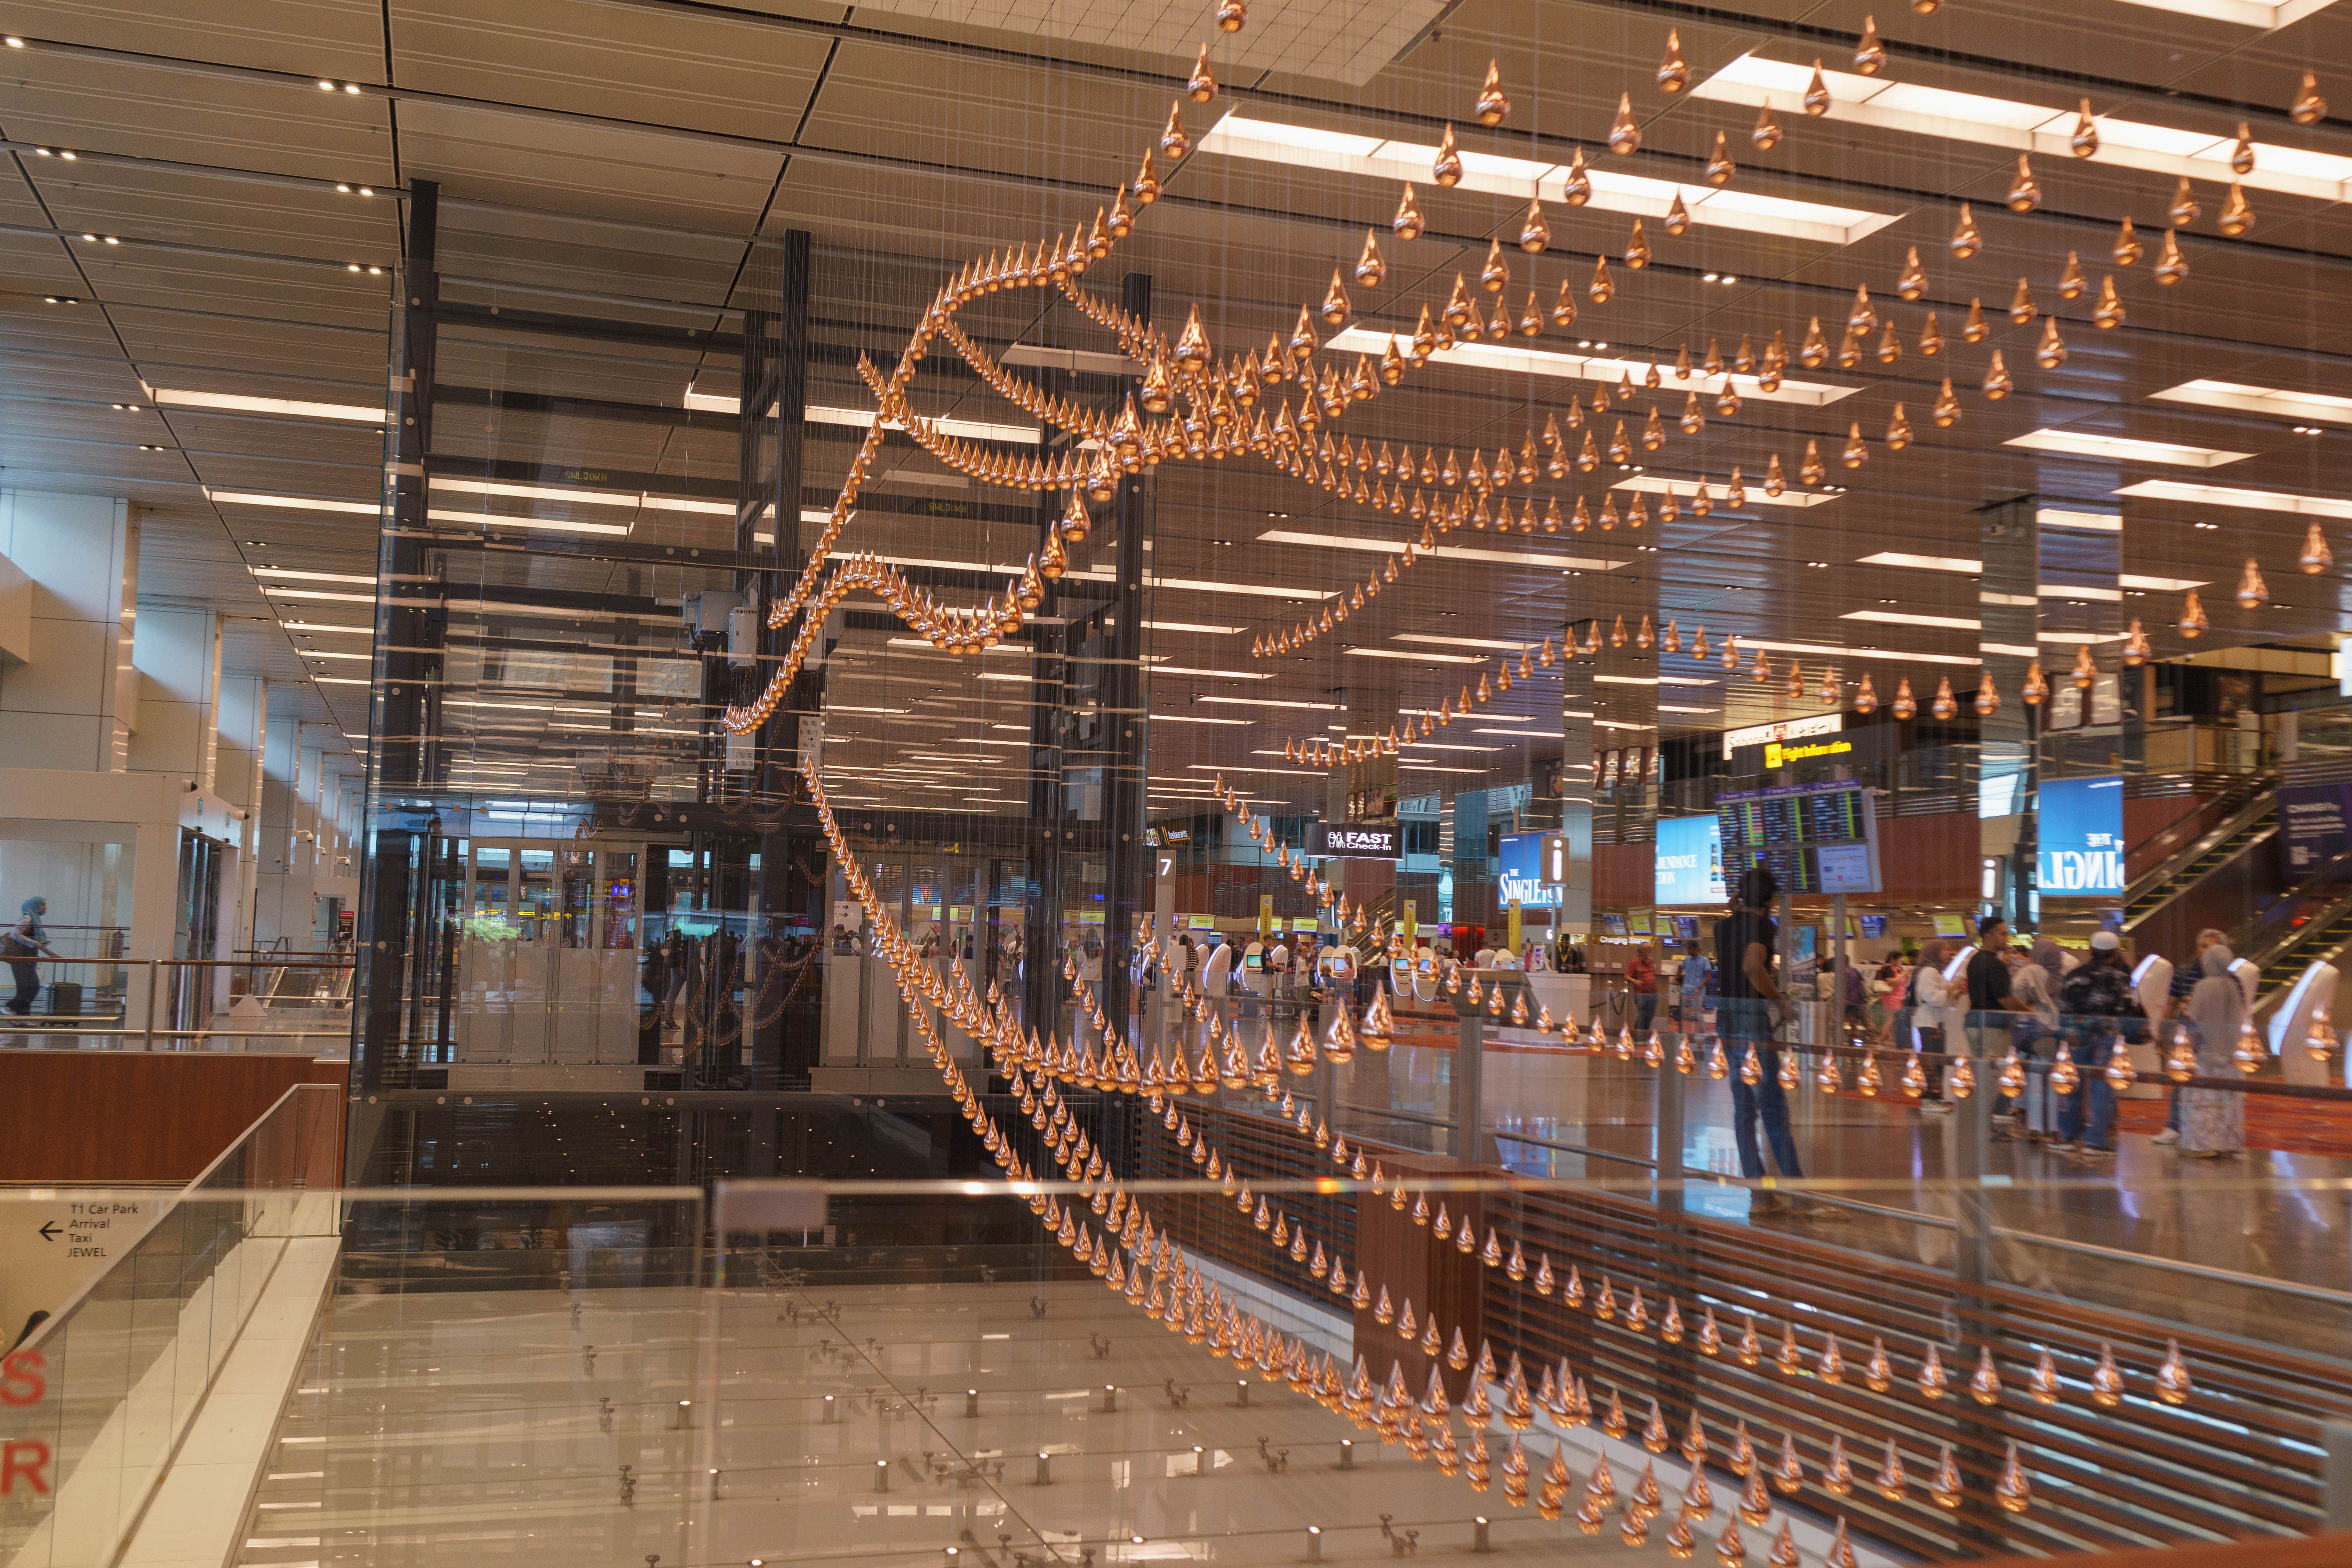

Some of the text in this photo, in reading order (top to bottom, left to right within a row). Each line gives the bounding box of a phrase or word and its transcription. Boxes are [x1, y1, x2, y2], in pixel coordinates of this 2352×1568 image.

[1782, 741, 1851, 761] Flight Information
[1168, 829, 1188, 839] Restaurants
[1347, 832, 1392, 844] FAST
[1160, 859, 1171, 876] 7
[1509, 868, 1519, 877] THE
[71, 1204, 138, 1214] T1 Car Park
[69, 1218, 110, 1229] Arrival
[69, 1233, 92, 1243] Taxi
[67, 1248, 107, 1257] JEWEL
[1, 1441, 52, 1497] R
